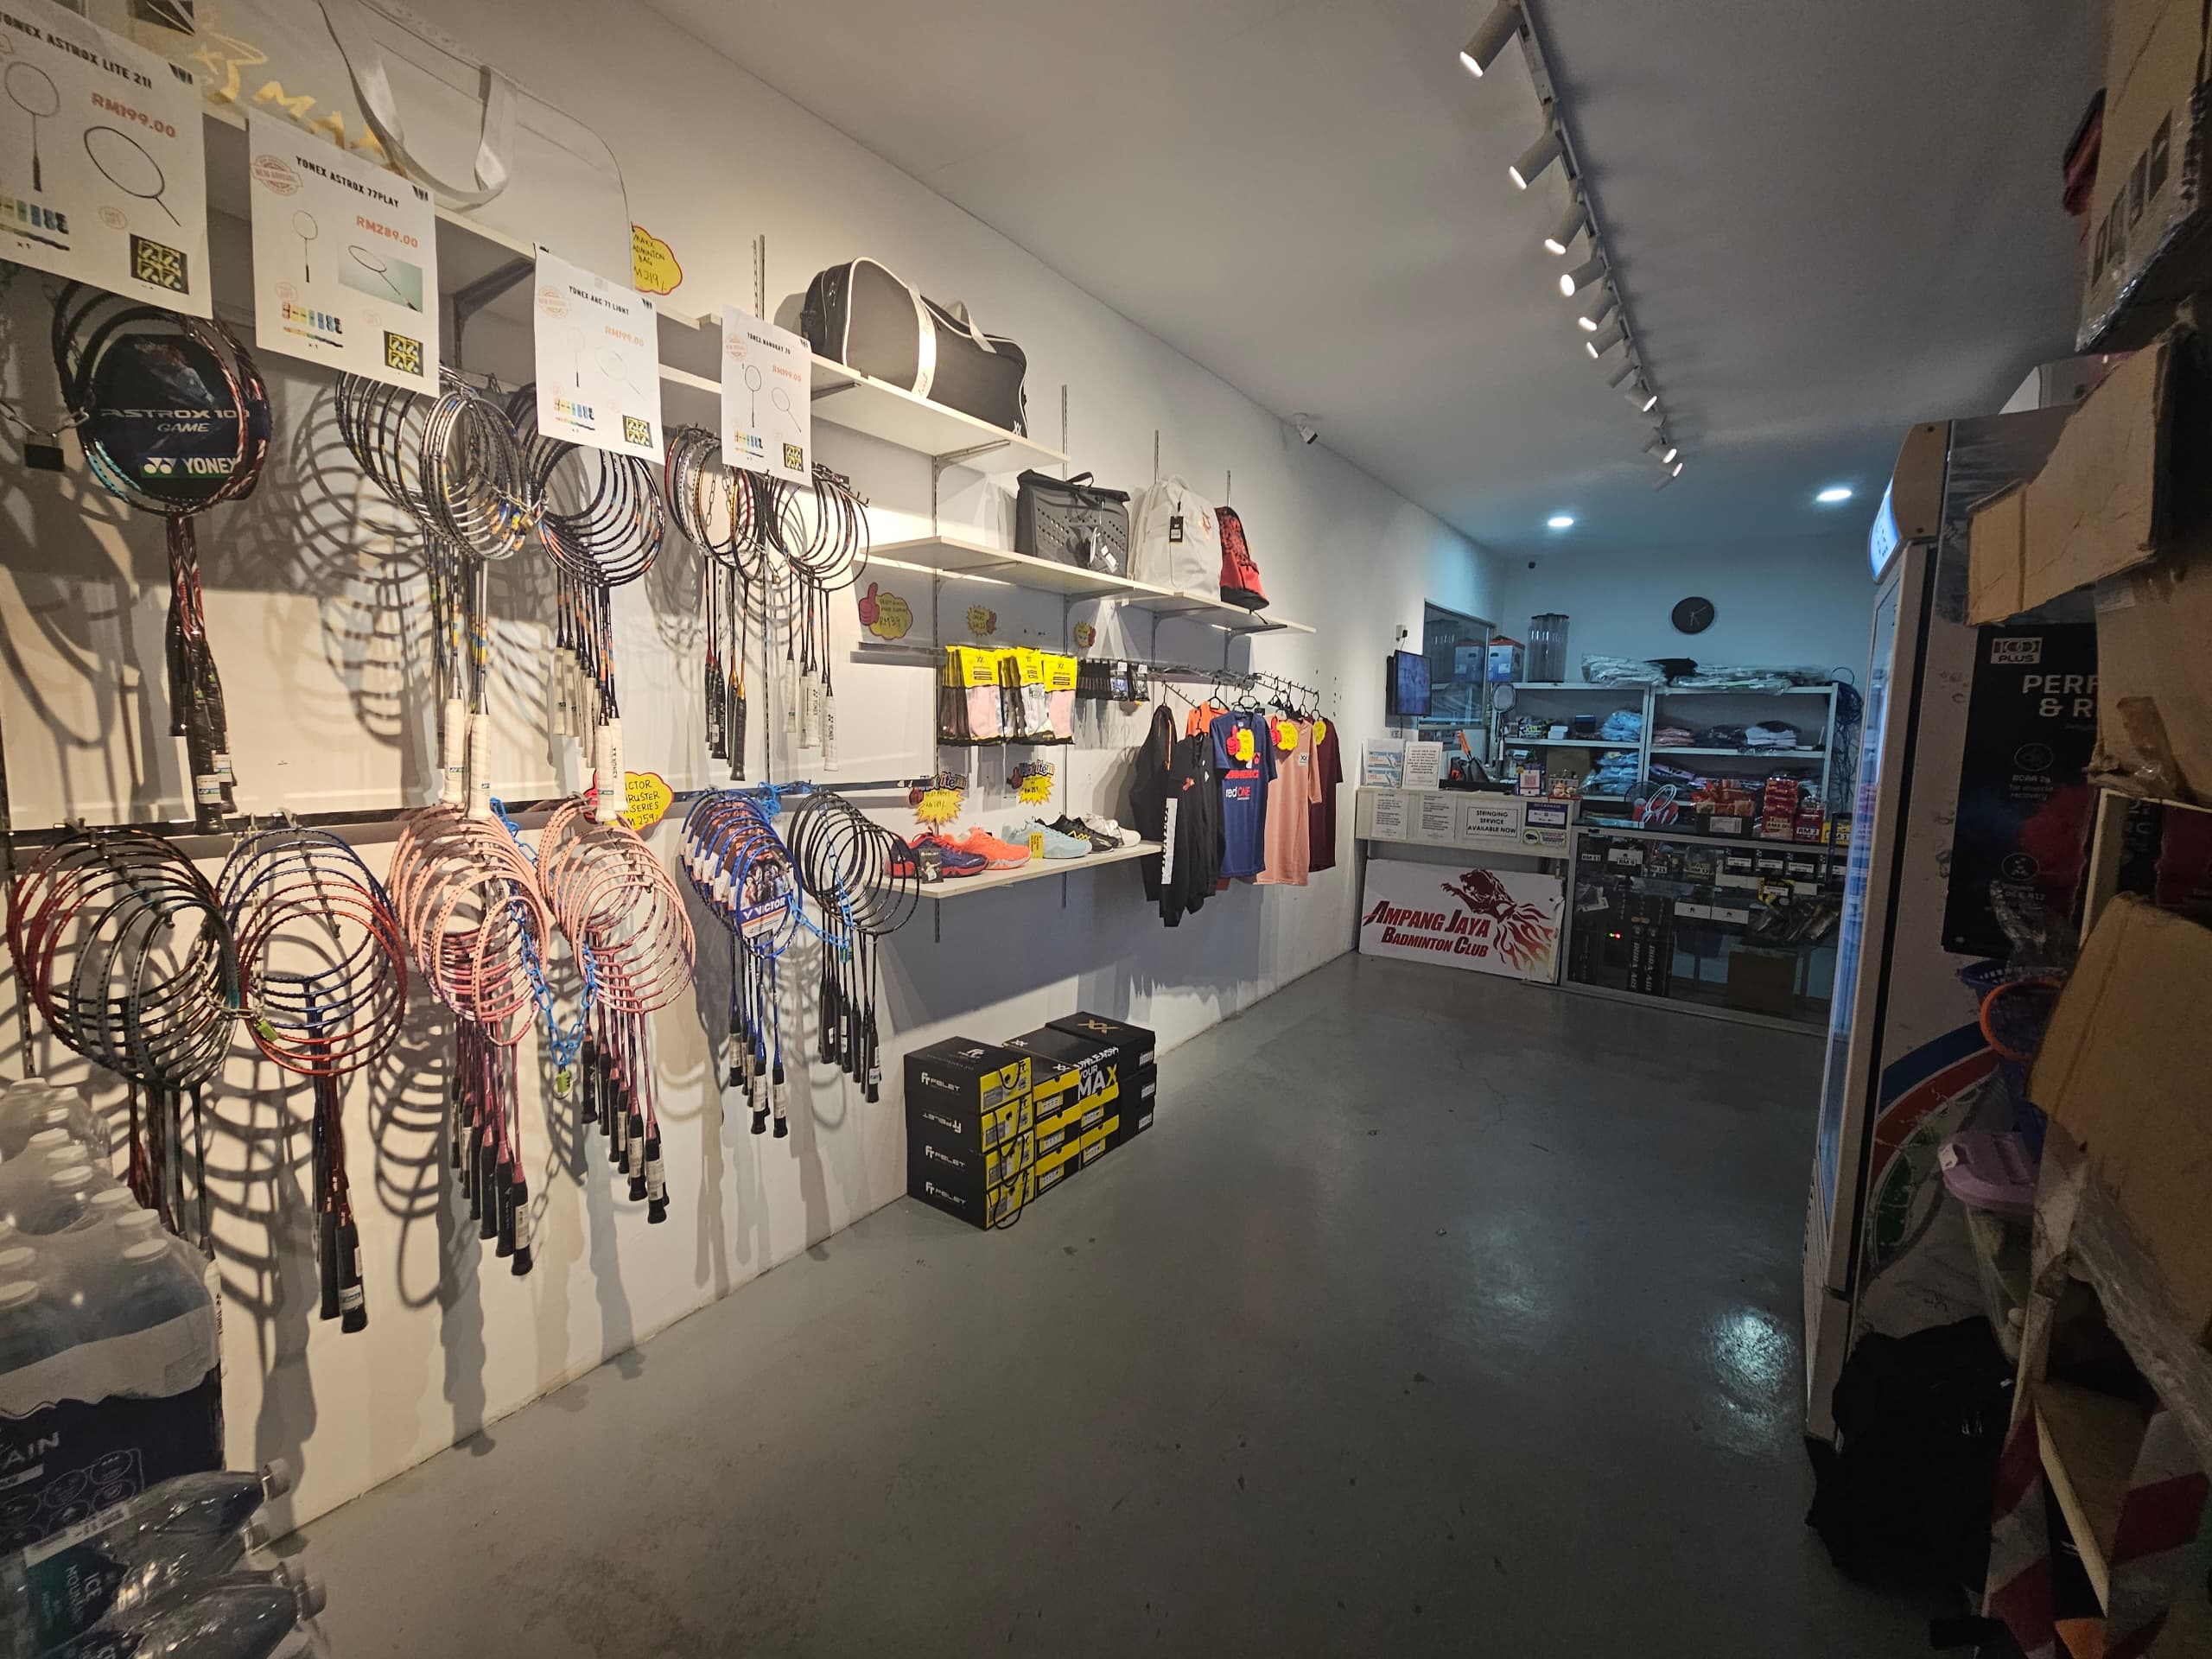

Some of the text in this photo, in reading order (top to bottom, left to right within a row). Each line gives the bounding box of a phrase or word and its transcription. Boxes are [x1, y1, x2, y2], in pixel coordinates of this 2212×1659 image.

[0, 13, 42, 40] ONEX
[47, 34, 99, 66] ASTROX
[103, 58, 130, 79] LITE
[91, 92, 176, 138] RM199.00
[296, 156, 399, 207] YONEX ASTROX 77PLAY
[357, 214, 418, 248] RM289.00
[569, 285, 588, 300] YONEX
[613, 304, 630, 316] LIGHT
[157, 423, 210, 433] GAME
[2039, 697, 2064, 718] &
[625, 779, 652, 791] ICTOR
[940, 772, 967, 791] item
[630, 802, 659, 813] SERIES
[754, 897, 785, 913] VICTOR
[1363, 900, 1491, 938] AMPANG JAYA
[1381, 926, 1489, 957] BADMINTON CLUB
[84, 1572, 103, 1597] ICE
